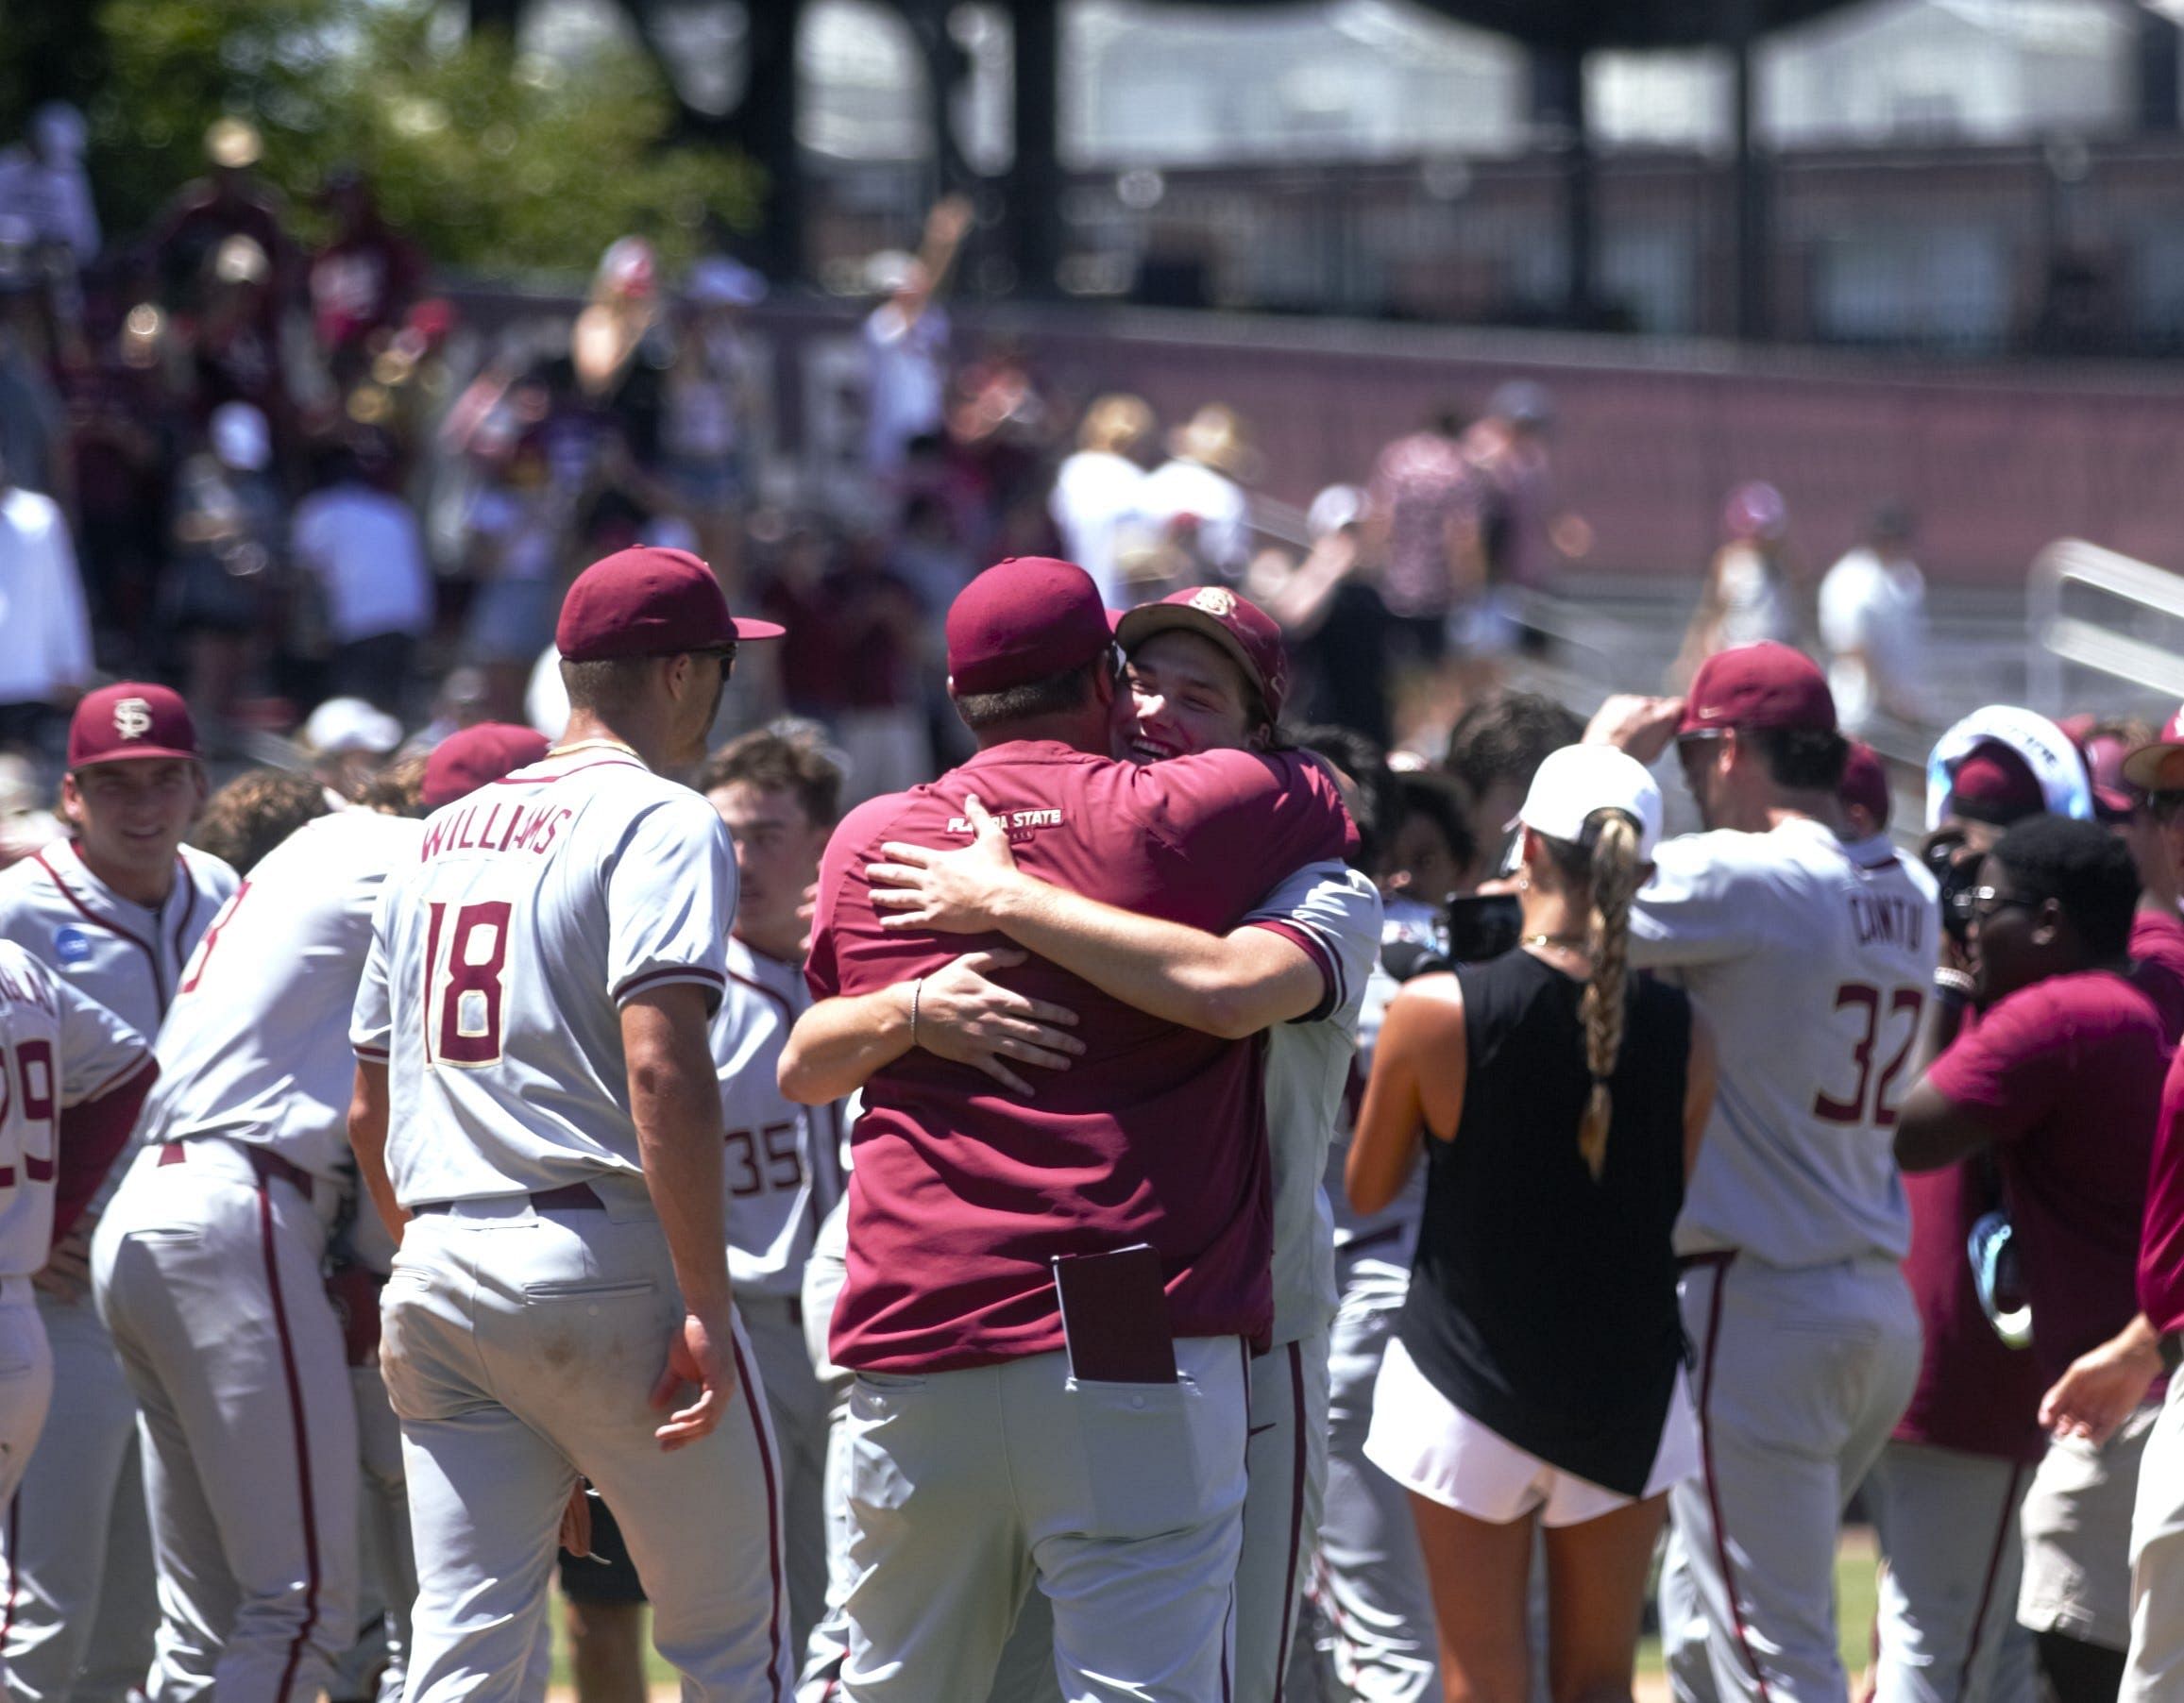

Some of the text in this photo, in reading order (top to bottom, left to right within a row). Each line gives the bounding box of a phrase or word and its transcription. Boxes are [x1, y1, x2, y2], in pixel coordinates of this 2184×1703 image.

[421, 801, 572, 864] WILLIAMS
[1013, 809, 1061, 828] STATE
[424, 900, 513, 1071] 18
[1813, 983, 1925, 1126] 32
[724, 1122, 803, 1197] 35
